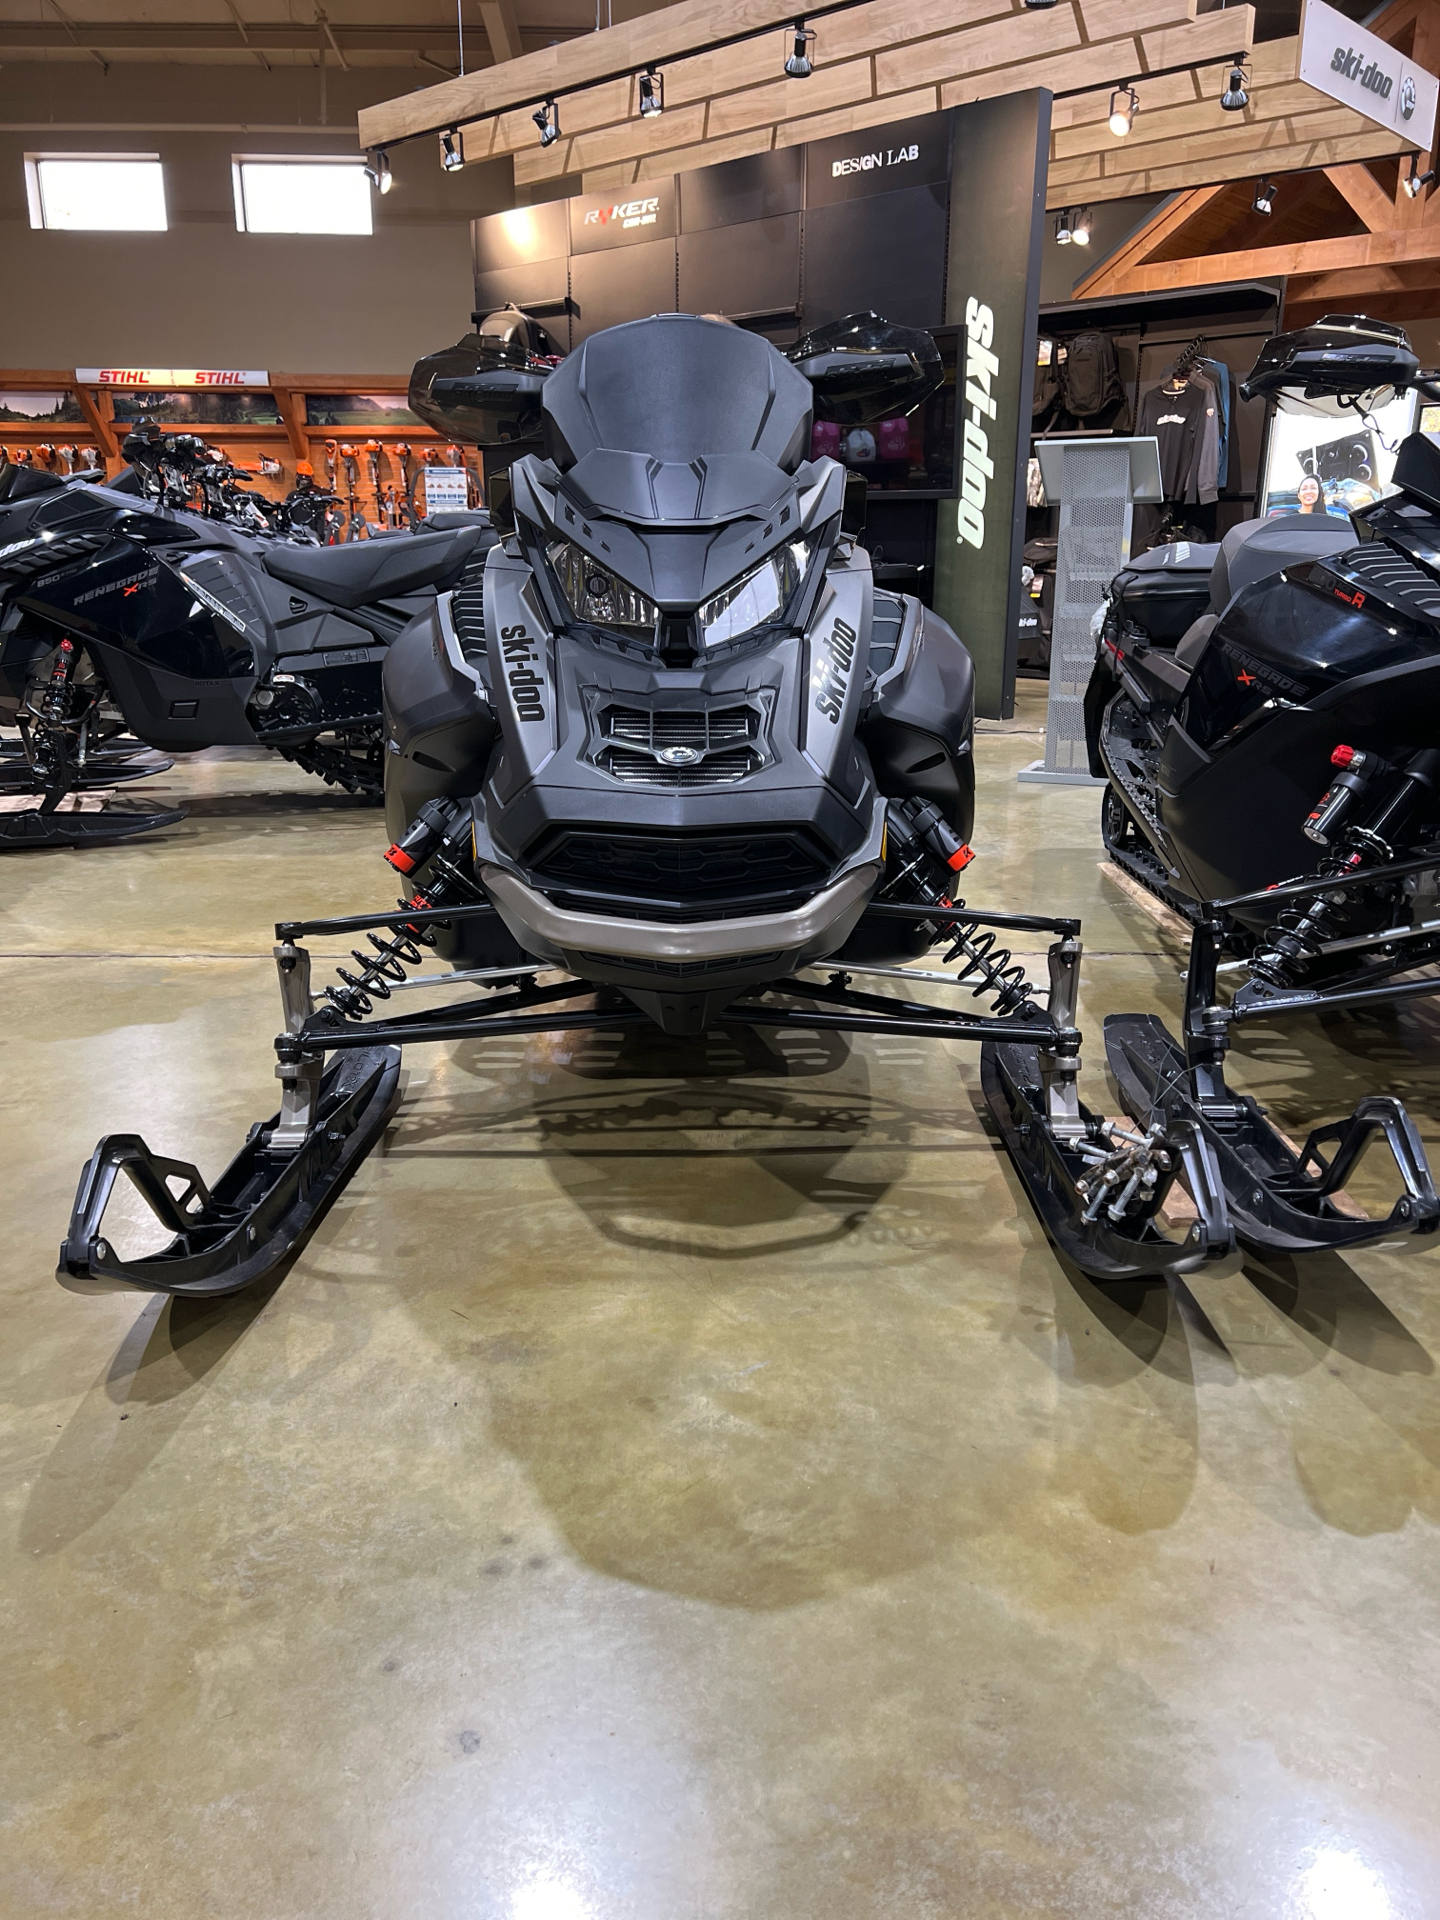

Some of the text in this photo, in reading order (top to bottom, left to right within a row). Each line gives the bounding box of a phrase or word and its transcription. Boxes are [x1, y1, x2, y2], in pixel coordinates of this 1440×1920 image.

[1330, 47, 1393, 99] ski-doo
[832, 145, 919, 177] DESIGN LAB
[584, 197, 658, 225] RYKER
[99, 371, 149, 383] STIHL
[195, 372, 245, 384] STIHL
[958, 296, 999, 549] ski-doo
[74, 565, 159, 606] RENEGADE
[1334, 588, 1366, 608] TURBO R
[500, 624, 545, 722] ski-doo
[814, 617, 857, 725] ski-doo
[1222, 643, 1306, 697] RENEGADE
